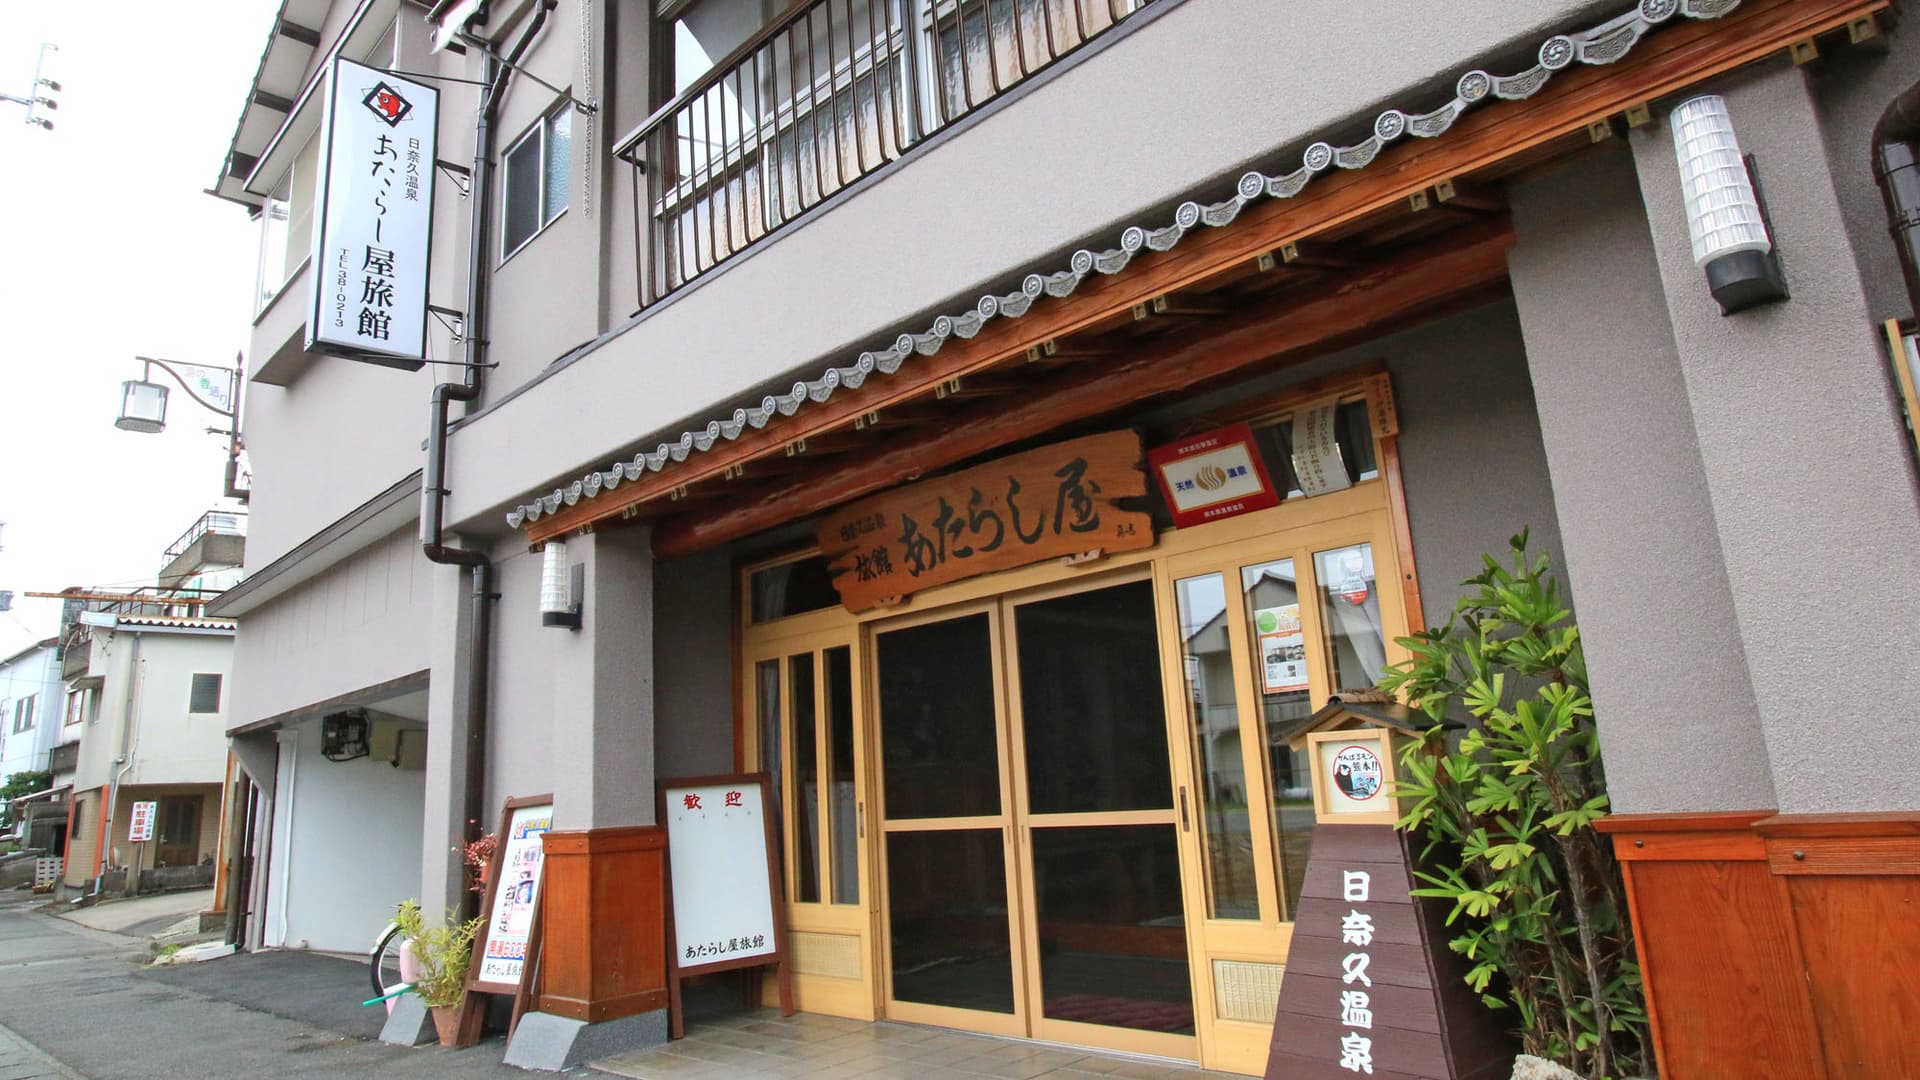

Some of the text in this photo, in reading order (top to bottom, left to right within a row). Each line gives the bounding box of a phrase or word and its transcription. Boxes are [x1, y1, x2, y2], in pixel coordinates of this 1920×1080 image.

[405, 137, 420, 201] 日奈久温泉
[357, 133, 397, 341] あたらし屋旅館
[897, 457, 1102, 578] あたらし屋
[1175, 465, 1248, 492] 天然 温泉
[685, 935, 765, 959] あたらし屋旅館
[1340, 870, 1375, 1075] 日奈久温泉
